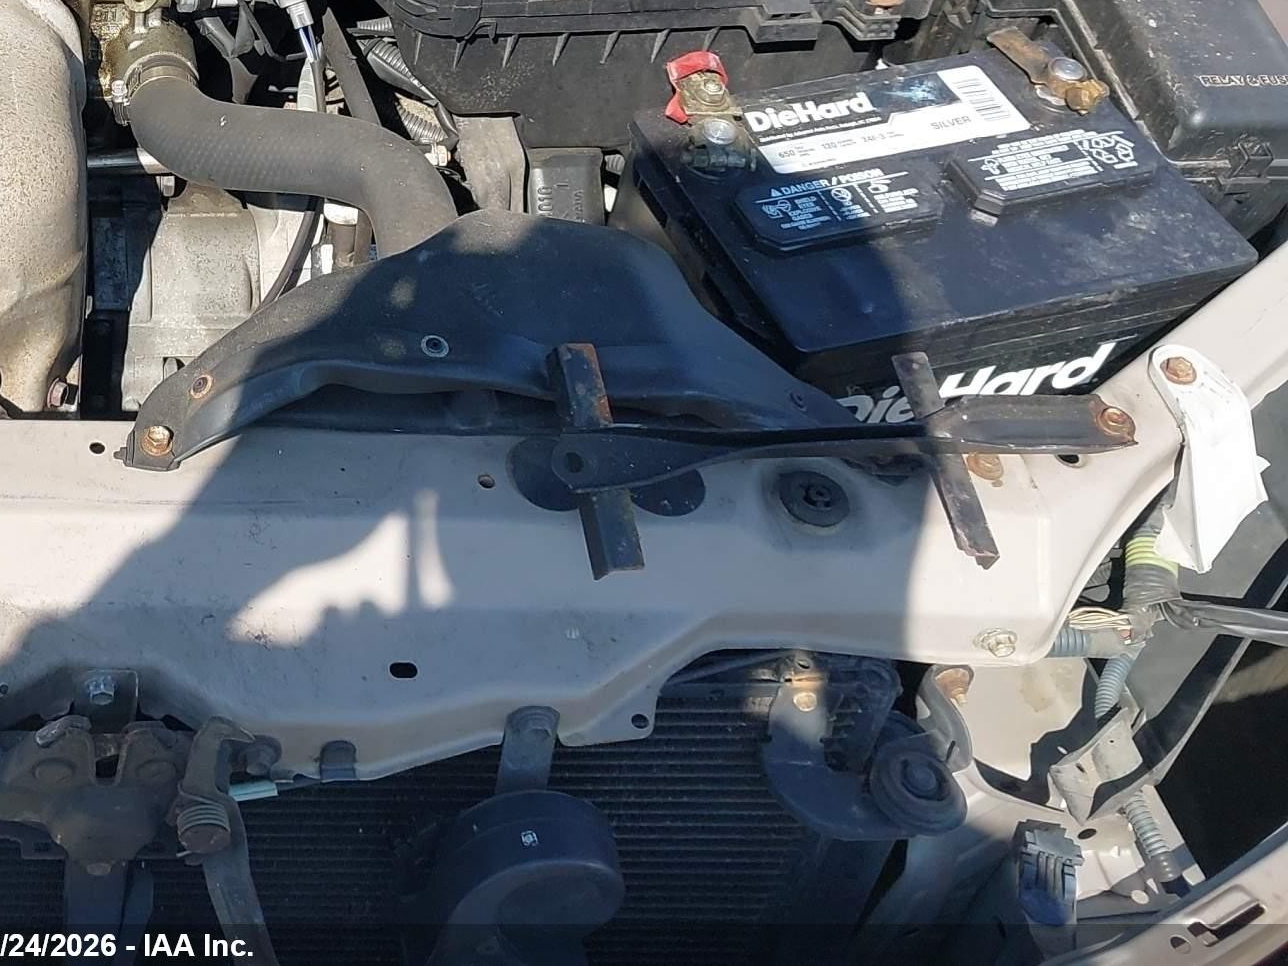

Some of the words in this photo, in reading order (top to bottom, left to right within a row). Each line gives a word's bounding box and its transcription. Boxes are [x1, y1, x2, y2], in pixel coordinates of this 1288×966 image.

[1199, 75, 1245, 87] RELAY
[744, 92, 877, 132] DieHard
[930, 115, 972, 130] SILVER
[781, 179, 831, 196] DANGER
[839, 168, 884, 184] POISON
